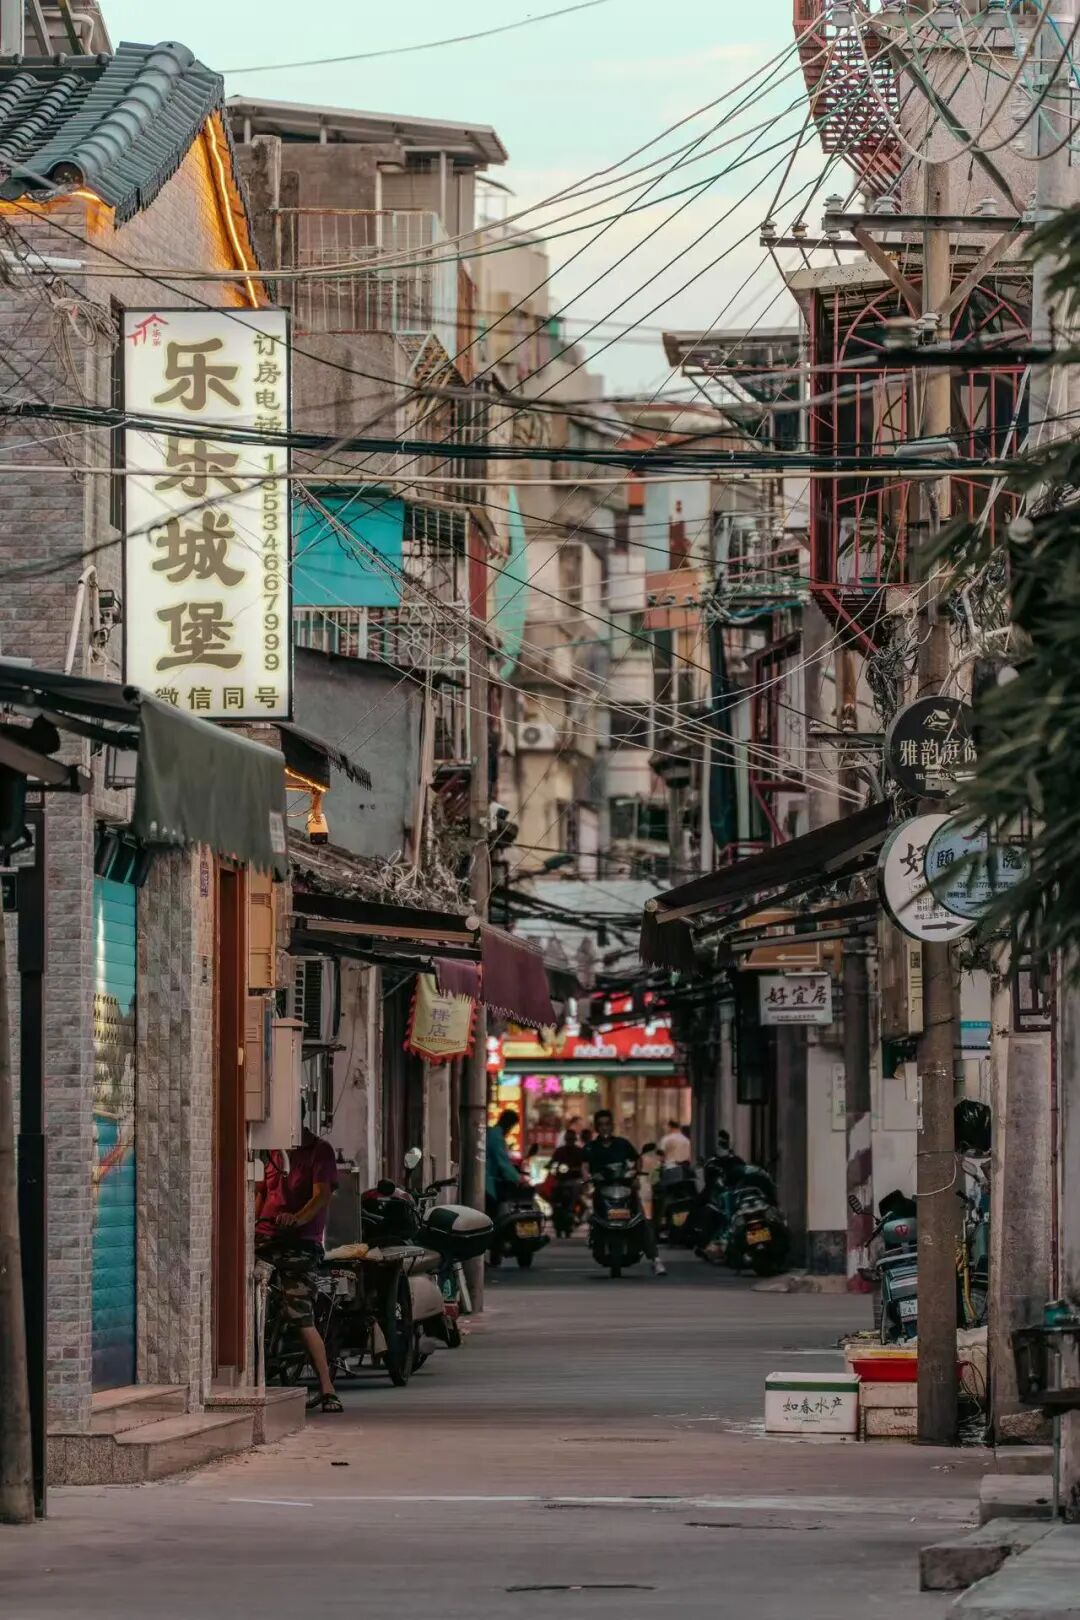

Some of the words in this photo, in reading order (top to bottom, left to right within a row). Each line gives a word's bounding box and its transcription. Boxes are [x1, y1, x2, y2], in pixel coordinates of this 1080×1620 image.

[152, 338, 245, 672] 乐乐城堡
[155, 686, 280, 710] 微信同号
[764, 985, 827, 1006] 好宜居
[782, 1396, 845, 1416] 如春水产
